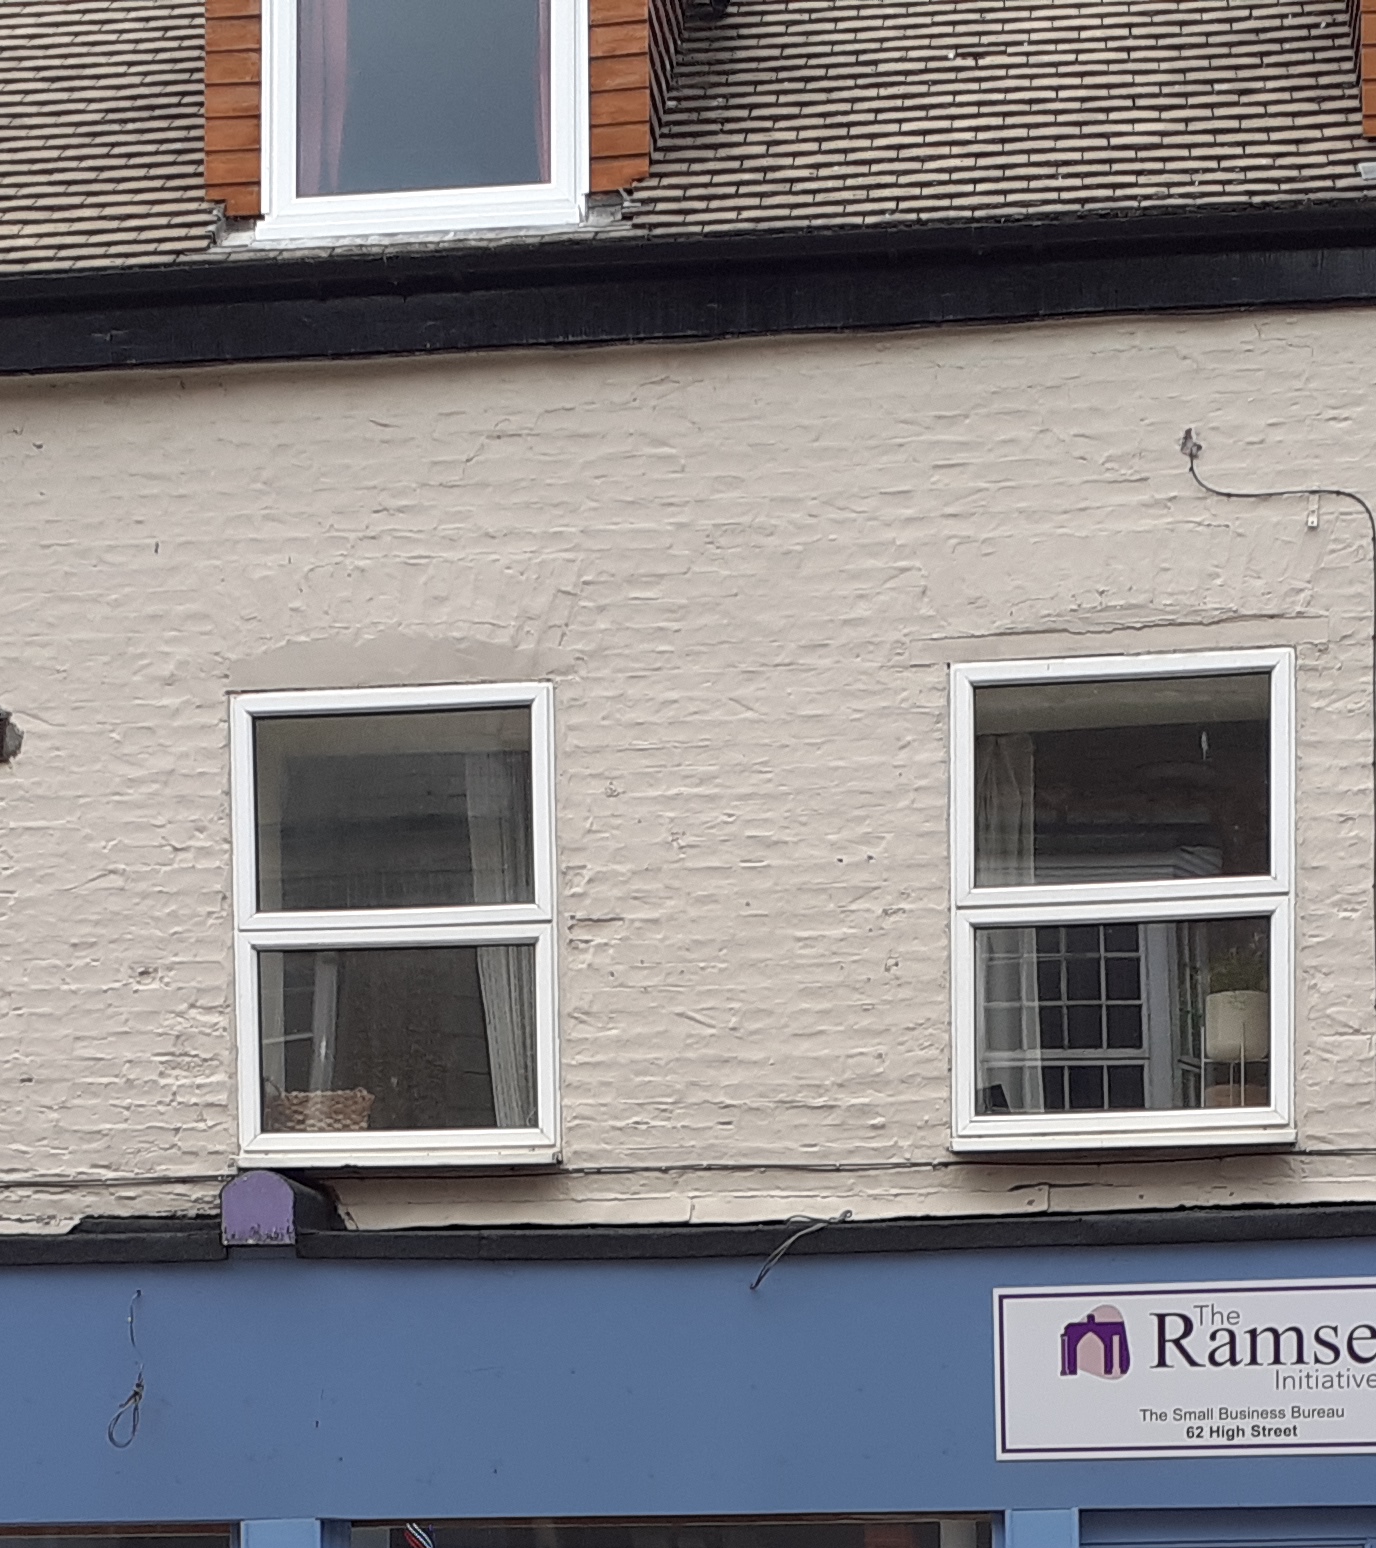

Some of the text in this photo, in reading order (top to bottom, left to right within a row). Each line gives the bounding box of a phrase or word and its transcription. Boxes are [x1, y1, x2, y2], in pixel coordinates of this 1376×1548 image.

[1193, 1303, 1241, 1326] The
[1139, 1405, 1345, 1422] The Small Business Bureau
[1186, 1425, 1298, 1441] 62 High Street
